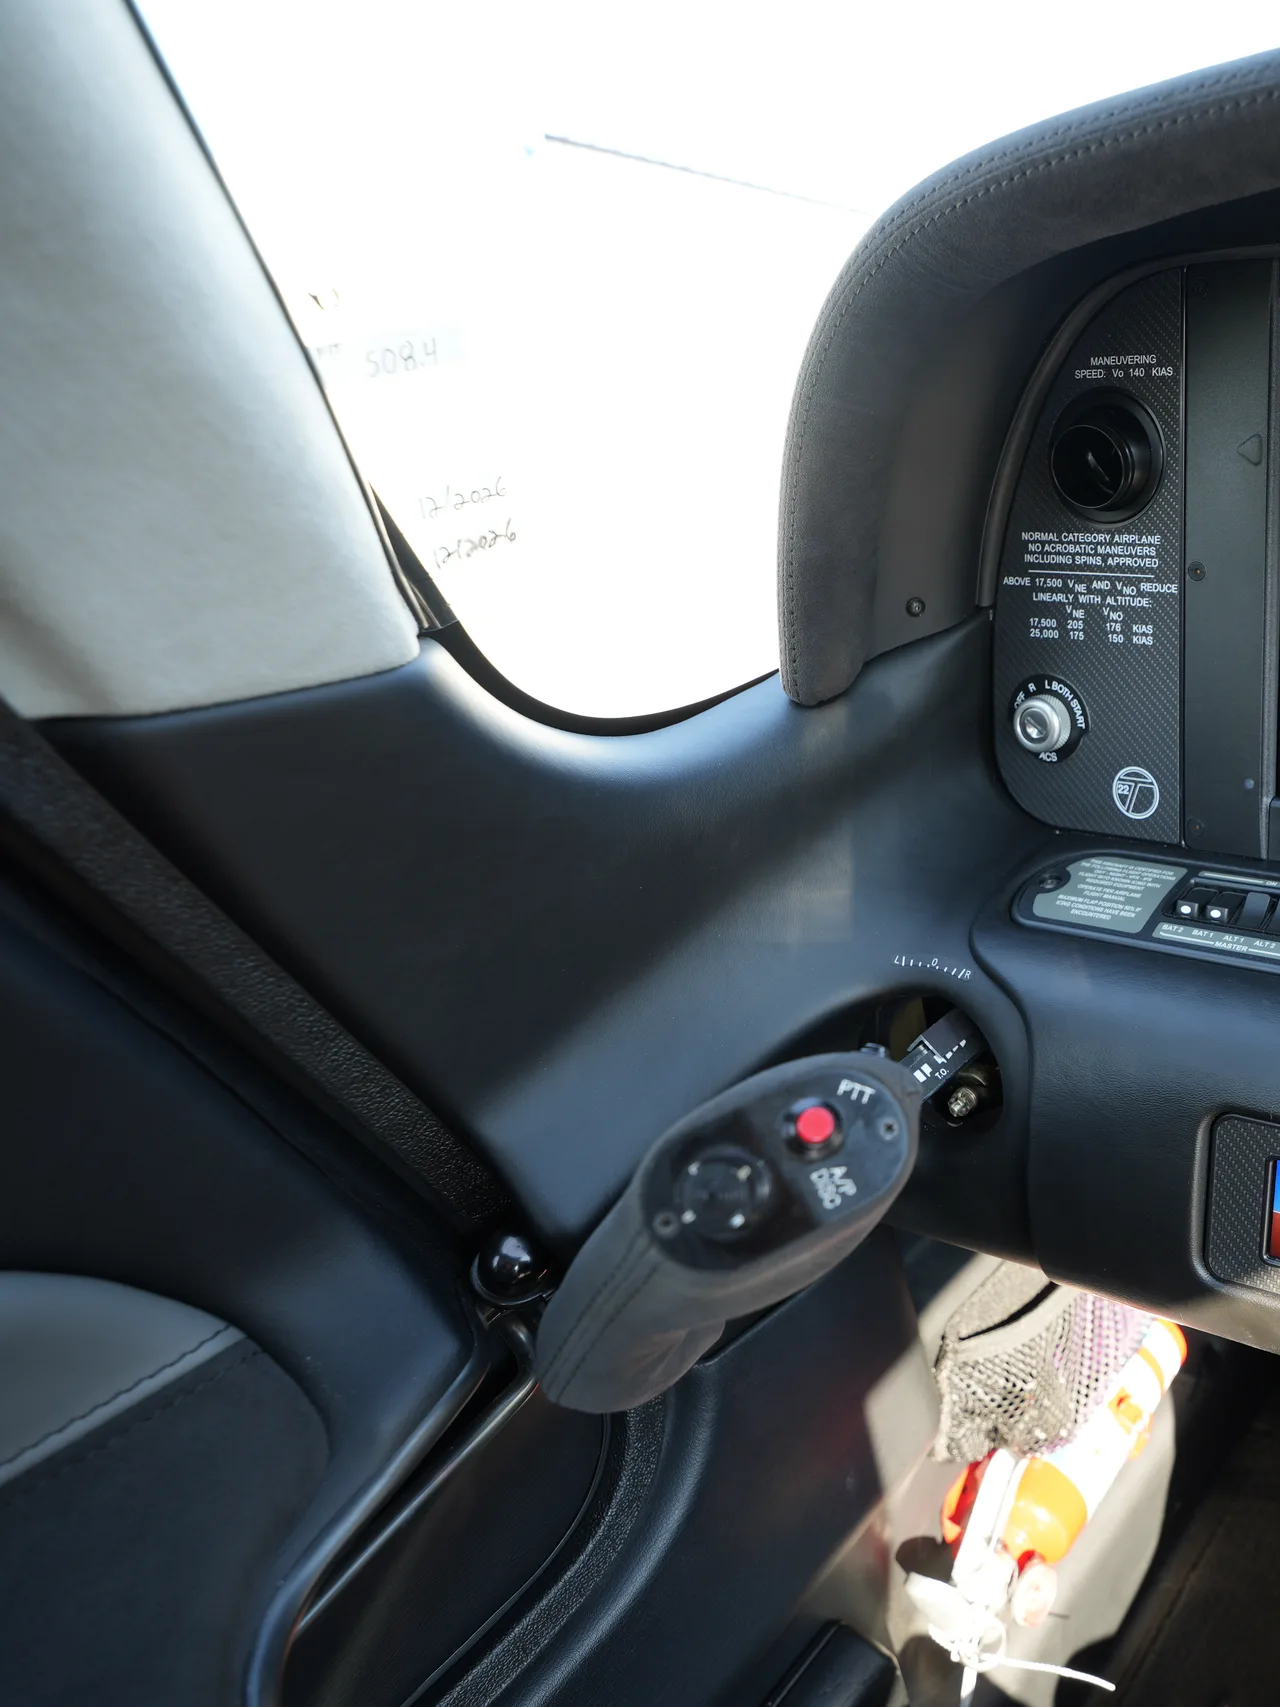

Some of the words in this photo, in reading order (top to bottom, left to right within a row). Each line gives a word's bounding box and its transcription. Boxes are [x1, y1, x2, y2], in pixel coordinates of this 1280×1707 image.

[1091, 355, 1156, 365] MANEUVERING
[1075, 370, 1106, 379] SPEED:
[1130, 368, 1145, 377] 140
[1152, 367, 1173, 376] KIAS
[1022, 532, 1059, 541] NORMAL
[1062, 533, 1110, 542] CATEGORY
[1114, 534, 1160, 544] AIRPLANE
[1029, 543, 1041, 552] NO
[1044, 544, 1094, 553] ACROBATIC
[1097, 545, 1156, 555] MANEUVERS
[1024, 554, 1072, 564] INCLUDING
[1075, 556, 1104, 566] SPINS,
[1107, 558, 1158, 567] APPROVED
[1003, 577, 1030, 585] ABOVE
[1036, 578, 1062, 588] 17,500
[1092, 581, 1110, 589] AND
[1141, 583, 1178, 593] REDUCE
[1033, 592, 1074, 602] LINEARLY
[1078, 595, 1100, 604] WITH
[1106, 596, 1151, 607] ALTITUDE:
[1030, 618, 1056, 627] 17,500
[1068, 620, 1083, 629] 205
[1106, 623, 1121, 632] 176
[1133, 624, 1153, 633] KIAS
[1030, 629, 1059, 638] 25,000
[1069, 631, 1084, 640] 175
[1108, 634, 1123, 643] 150
[1133, 636, 1153, 645] KIAS
[1052, 681, 1073, 701] BOTH
[1071, 700, 1085, 729] START
[1039, 752, 1057, 762] ACS
[1215, 941, 1248, 951] MASTER
[837, 1079, 876, 1104] PTT
